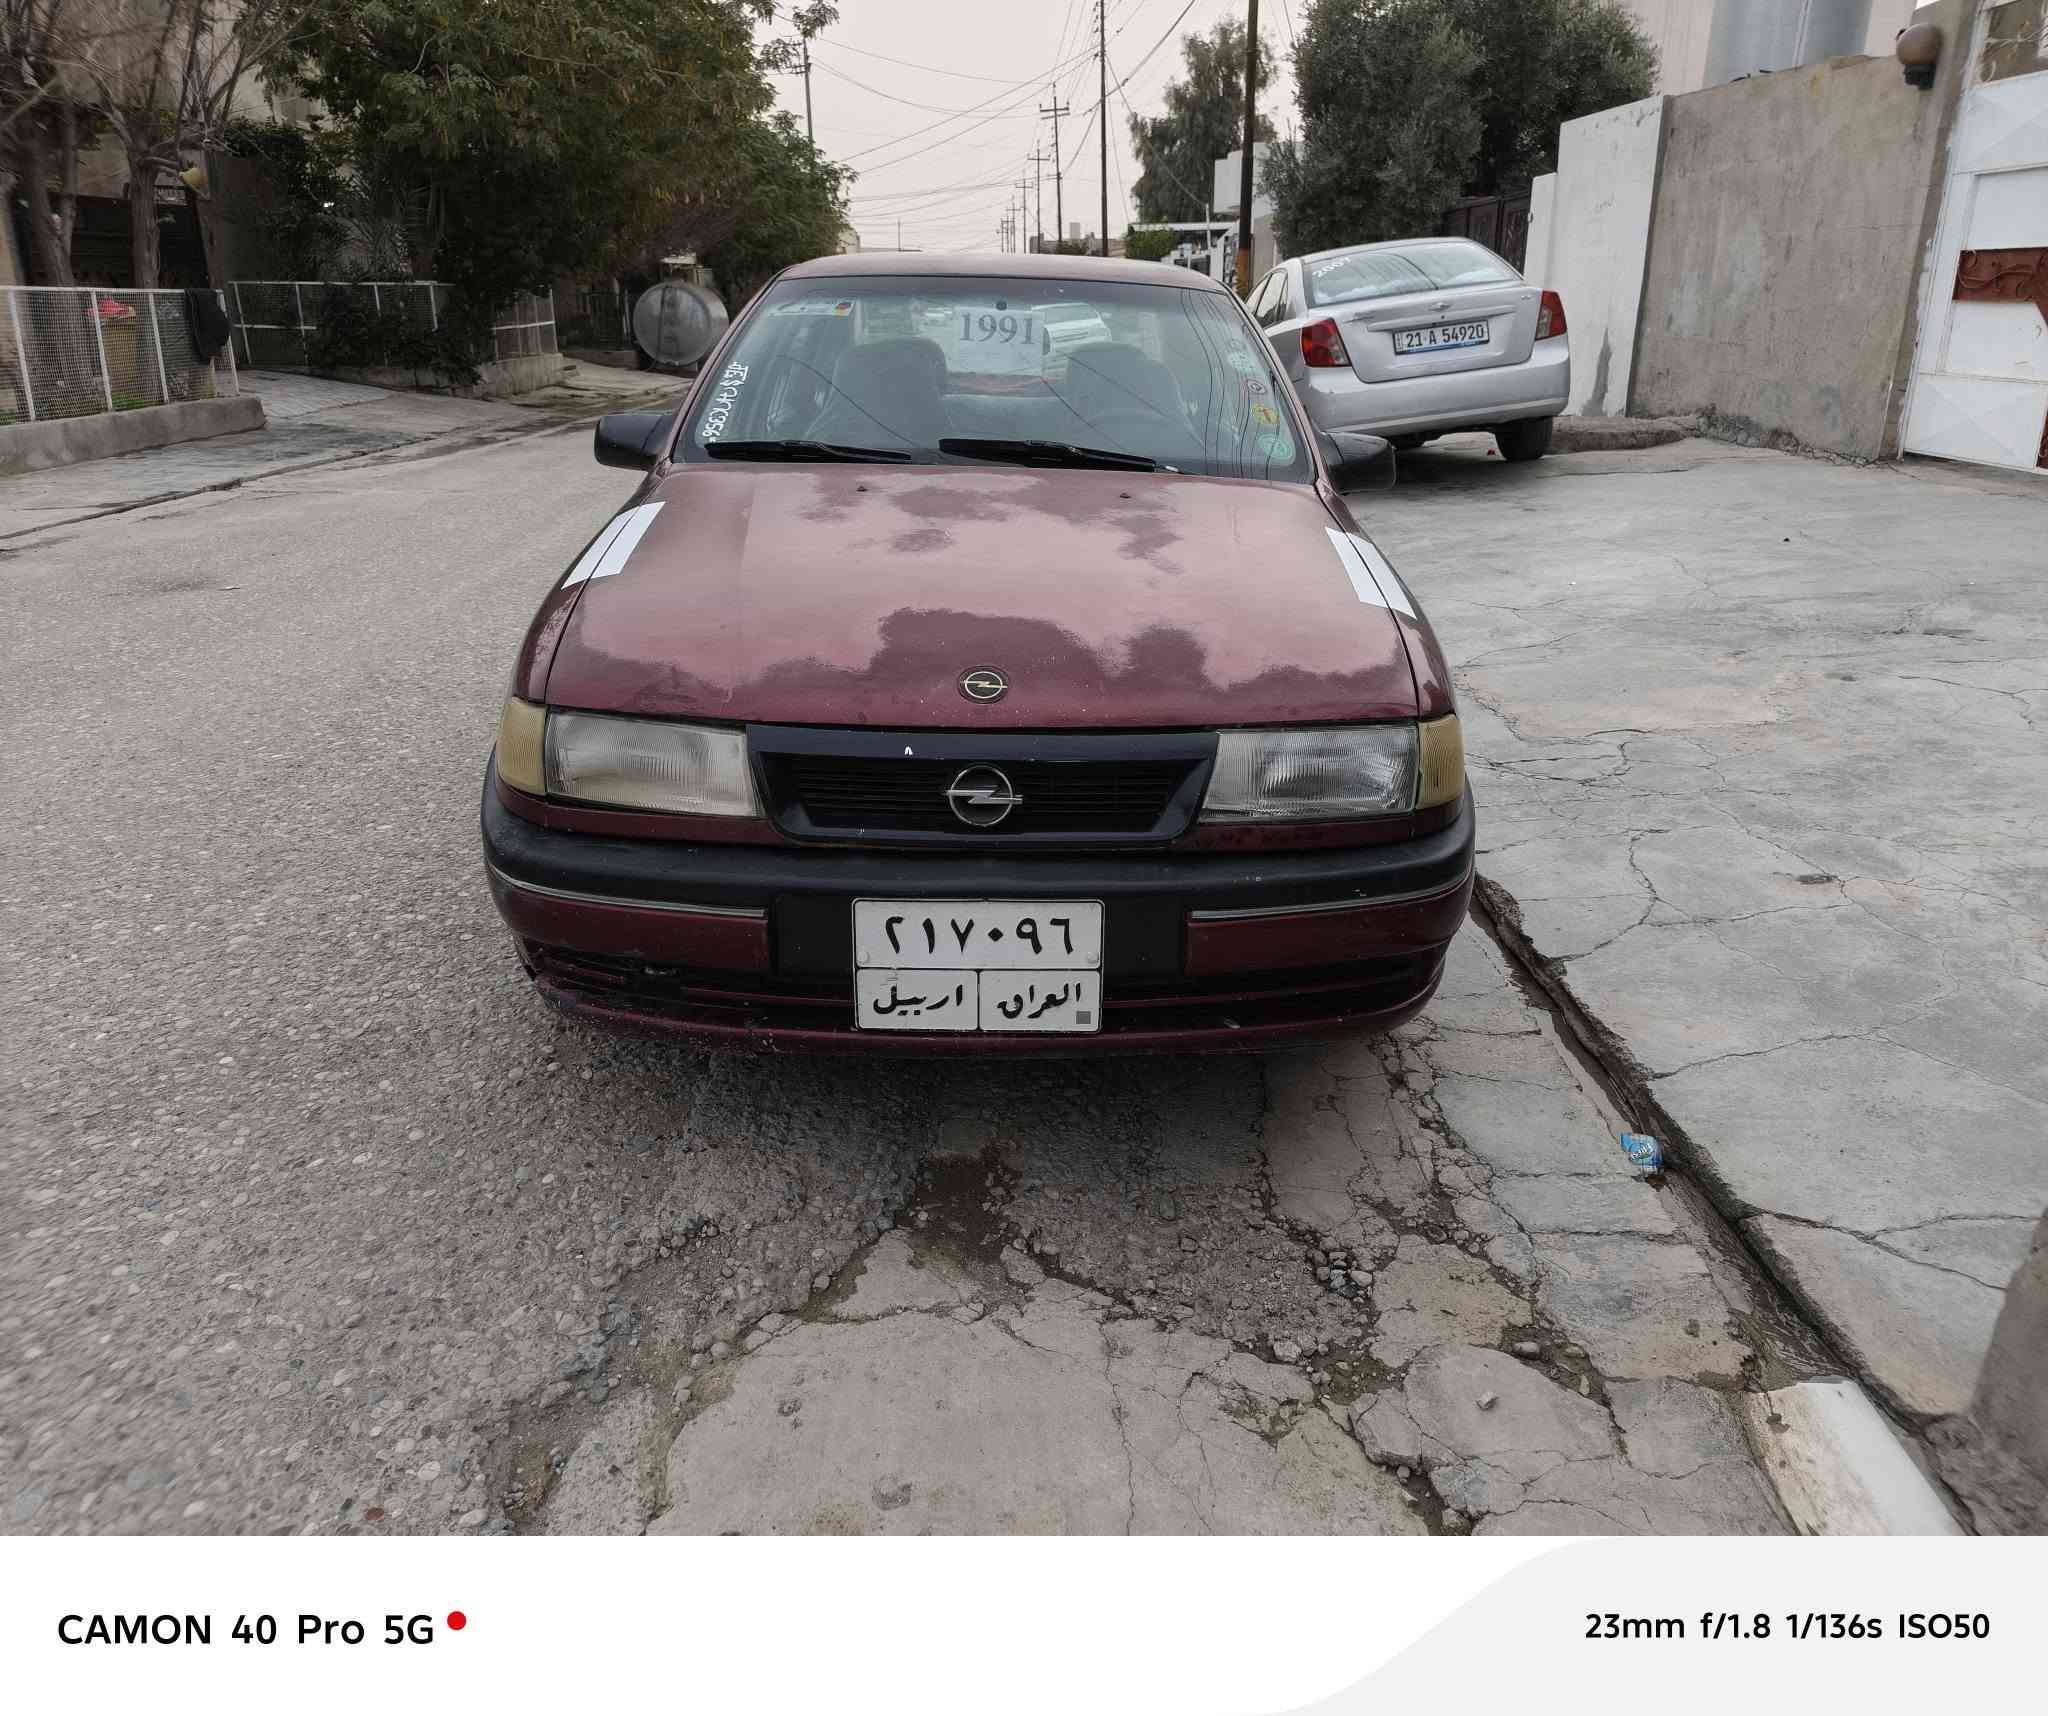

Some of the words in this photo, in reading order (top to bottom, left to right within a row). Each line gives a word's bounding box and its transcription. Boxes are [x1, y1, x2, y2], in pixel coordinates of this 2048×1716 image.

[959, 312, 1035, 345] 1991
[1406, 332, 1423, 348] 21
[1429, 330, 1437, 345] A
[1442, 324, 1484, 343] 54920
[885, 916, 1075, 955] ٢١٧٠٩٦
[873, 983, 963, 1017] اربيل
[997, 982, 1081, 1019] العراق
